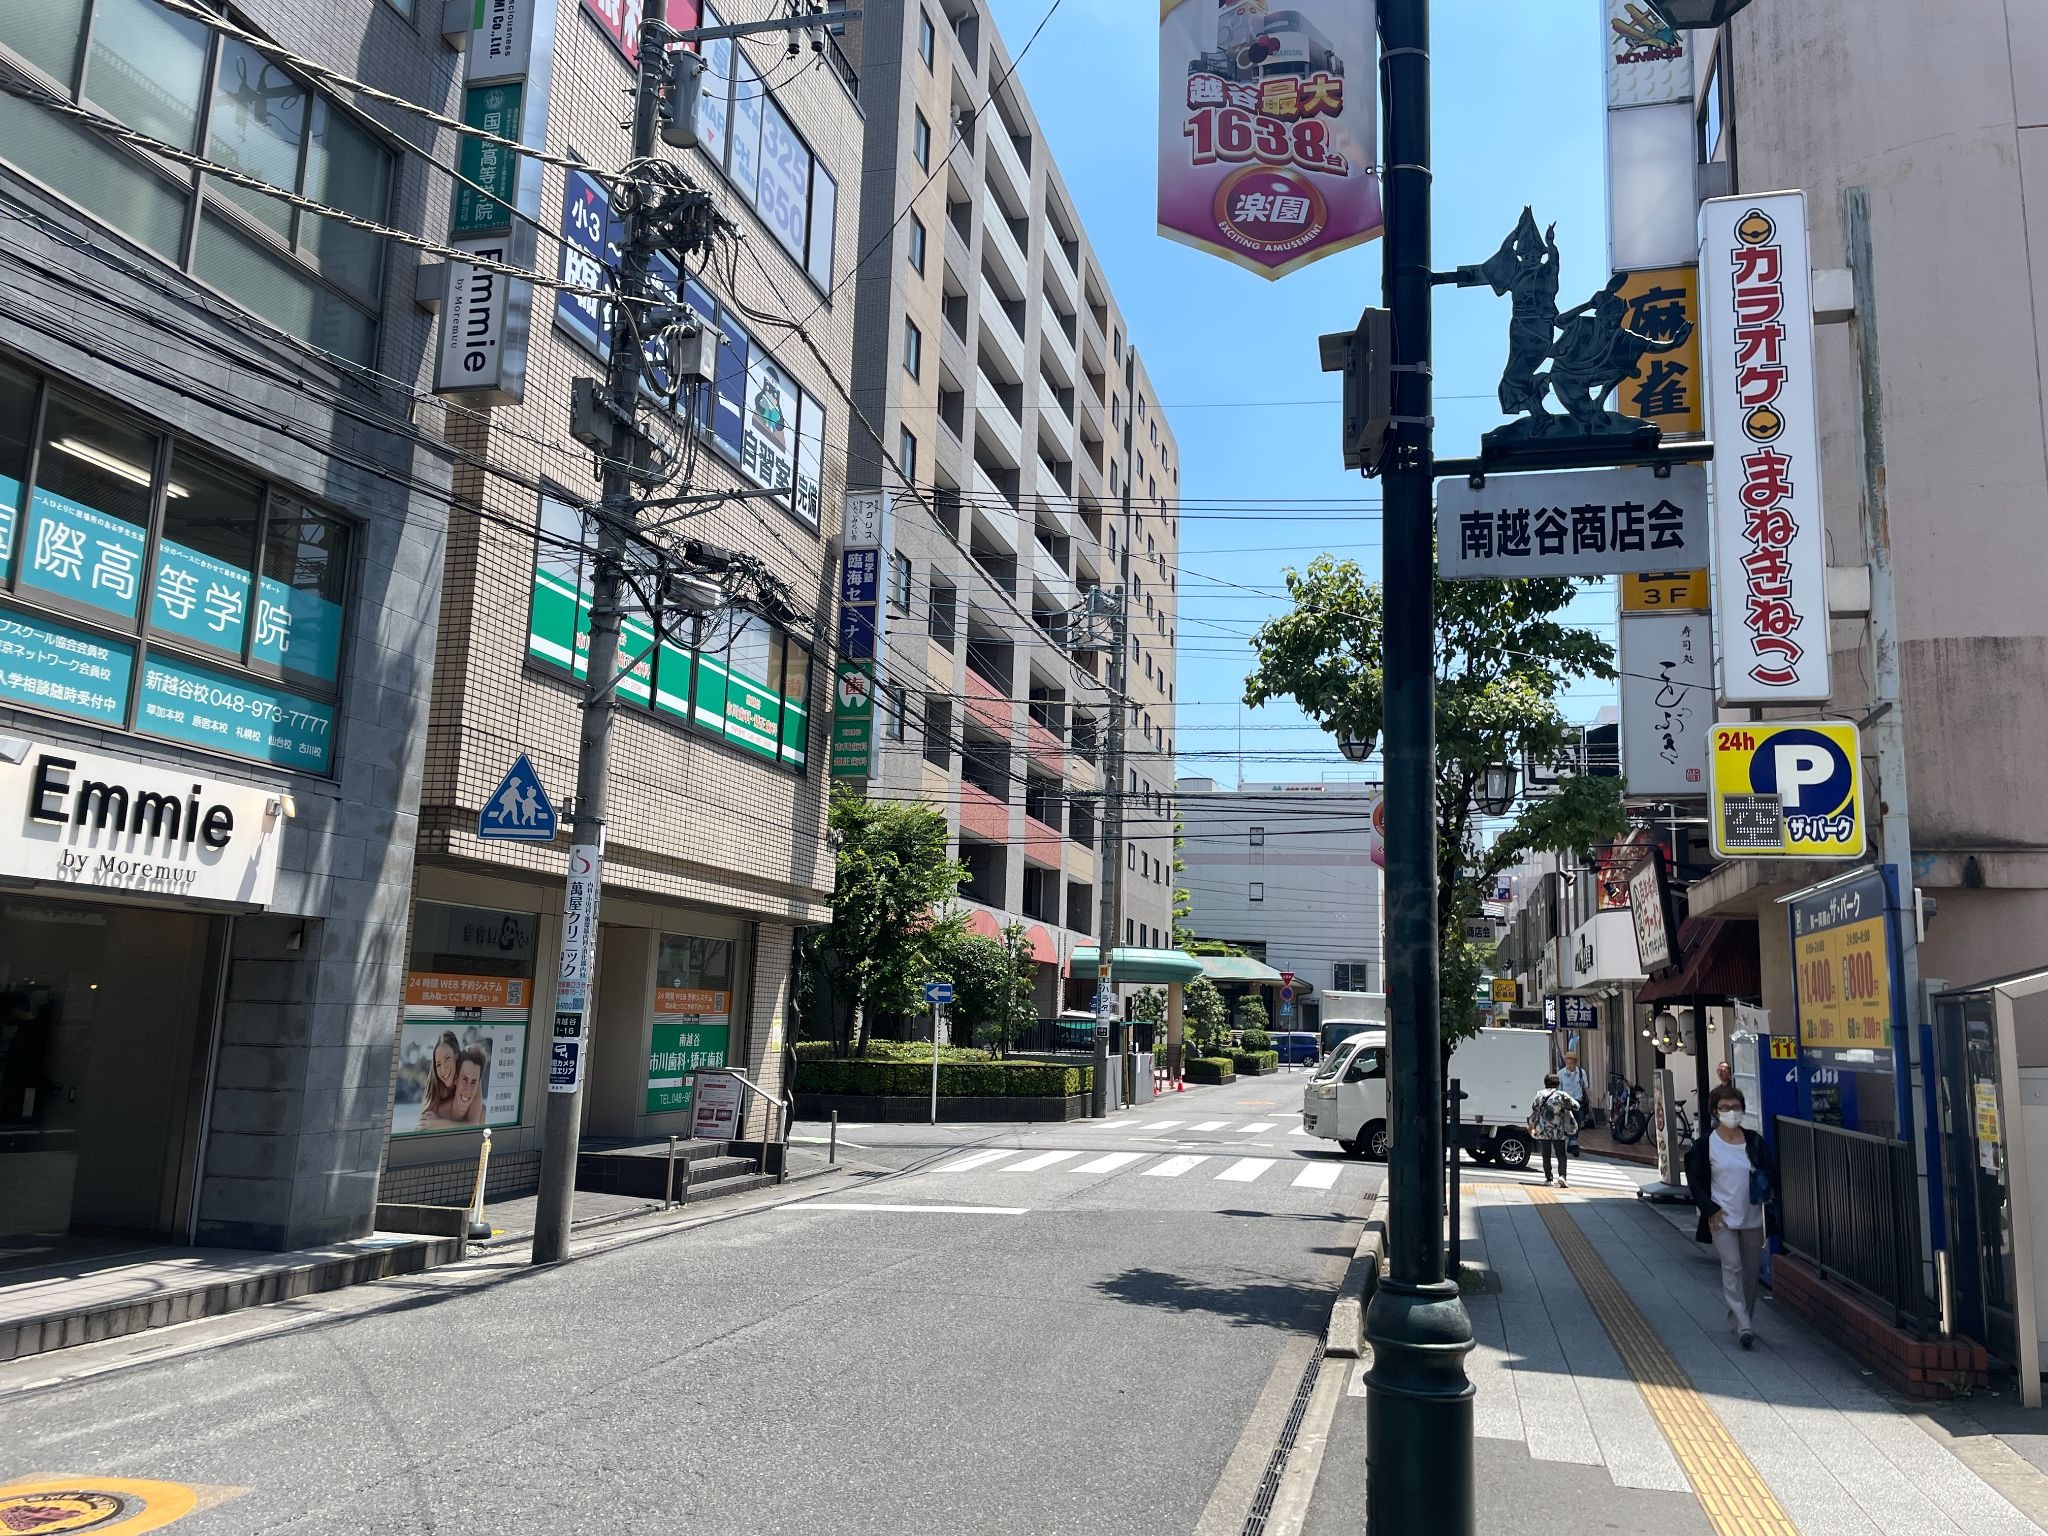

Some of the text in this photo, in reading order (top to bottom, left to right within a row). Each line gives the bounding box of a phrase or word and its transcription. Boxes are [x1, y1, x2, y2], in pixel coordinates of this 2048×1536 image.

[1188, 75, 1343, 117] 越谷最大
[1233, 192, 1311, 224] 楽園
[1218, 220, 1324, 252] EXCITING AMUSEMENT
[451, 279, 464, 349] by Moremuu
[463, 248, 503, 372] Emmie
[1733, 246, 1786, 408] カラオケ
[1459, 499, 1685, 560] 南越谷商店会
[1740, 448, 1802, 685] まねきねこ
[1643, 588, 1688, 604] 3F
[145, 703, 185, 724] 草加本校
[268, 735, 293, 751] 仙台校
[298, 743, 322, 758] 古川校
[1718, 731, 1756, 752] 24h
[1774, 744, 1835, 808] P
[30, 753, 234, 848] Emmie
[1725, 797, 1782, 846] 空
[1789, 816, 1853, 843] ザ・パーク
[62, 849, 197, 883] by Moremuu
[563, 881, 584, 978] 萬屋クリニック
[409, 979, 421, 988] 24
[440, 980, 459, 989] WEB
[649, 1050, 724, 1072] 市川歯科・矯正歯科
[679, 1033, 701, 1047] 南越谷
